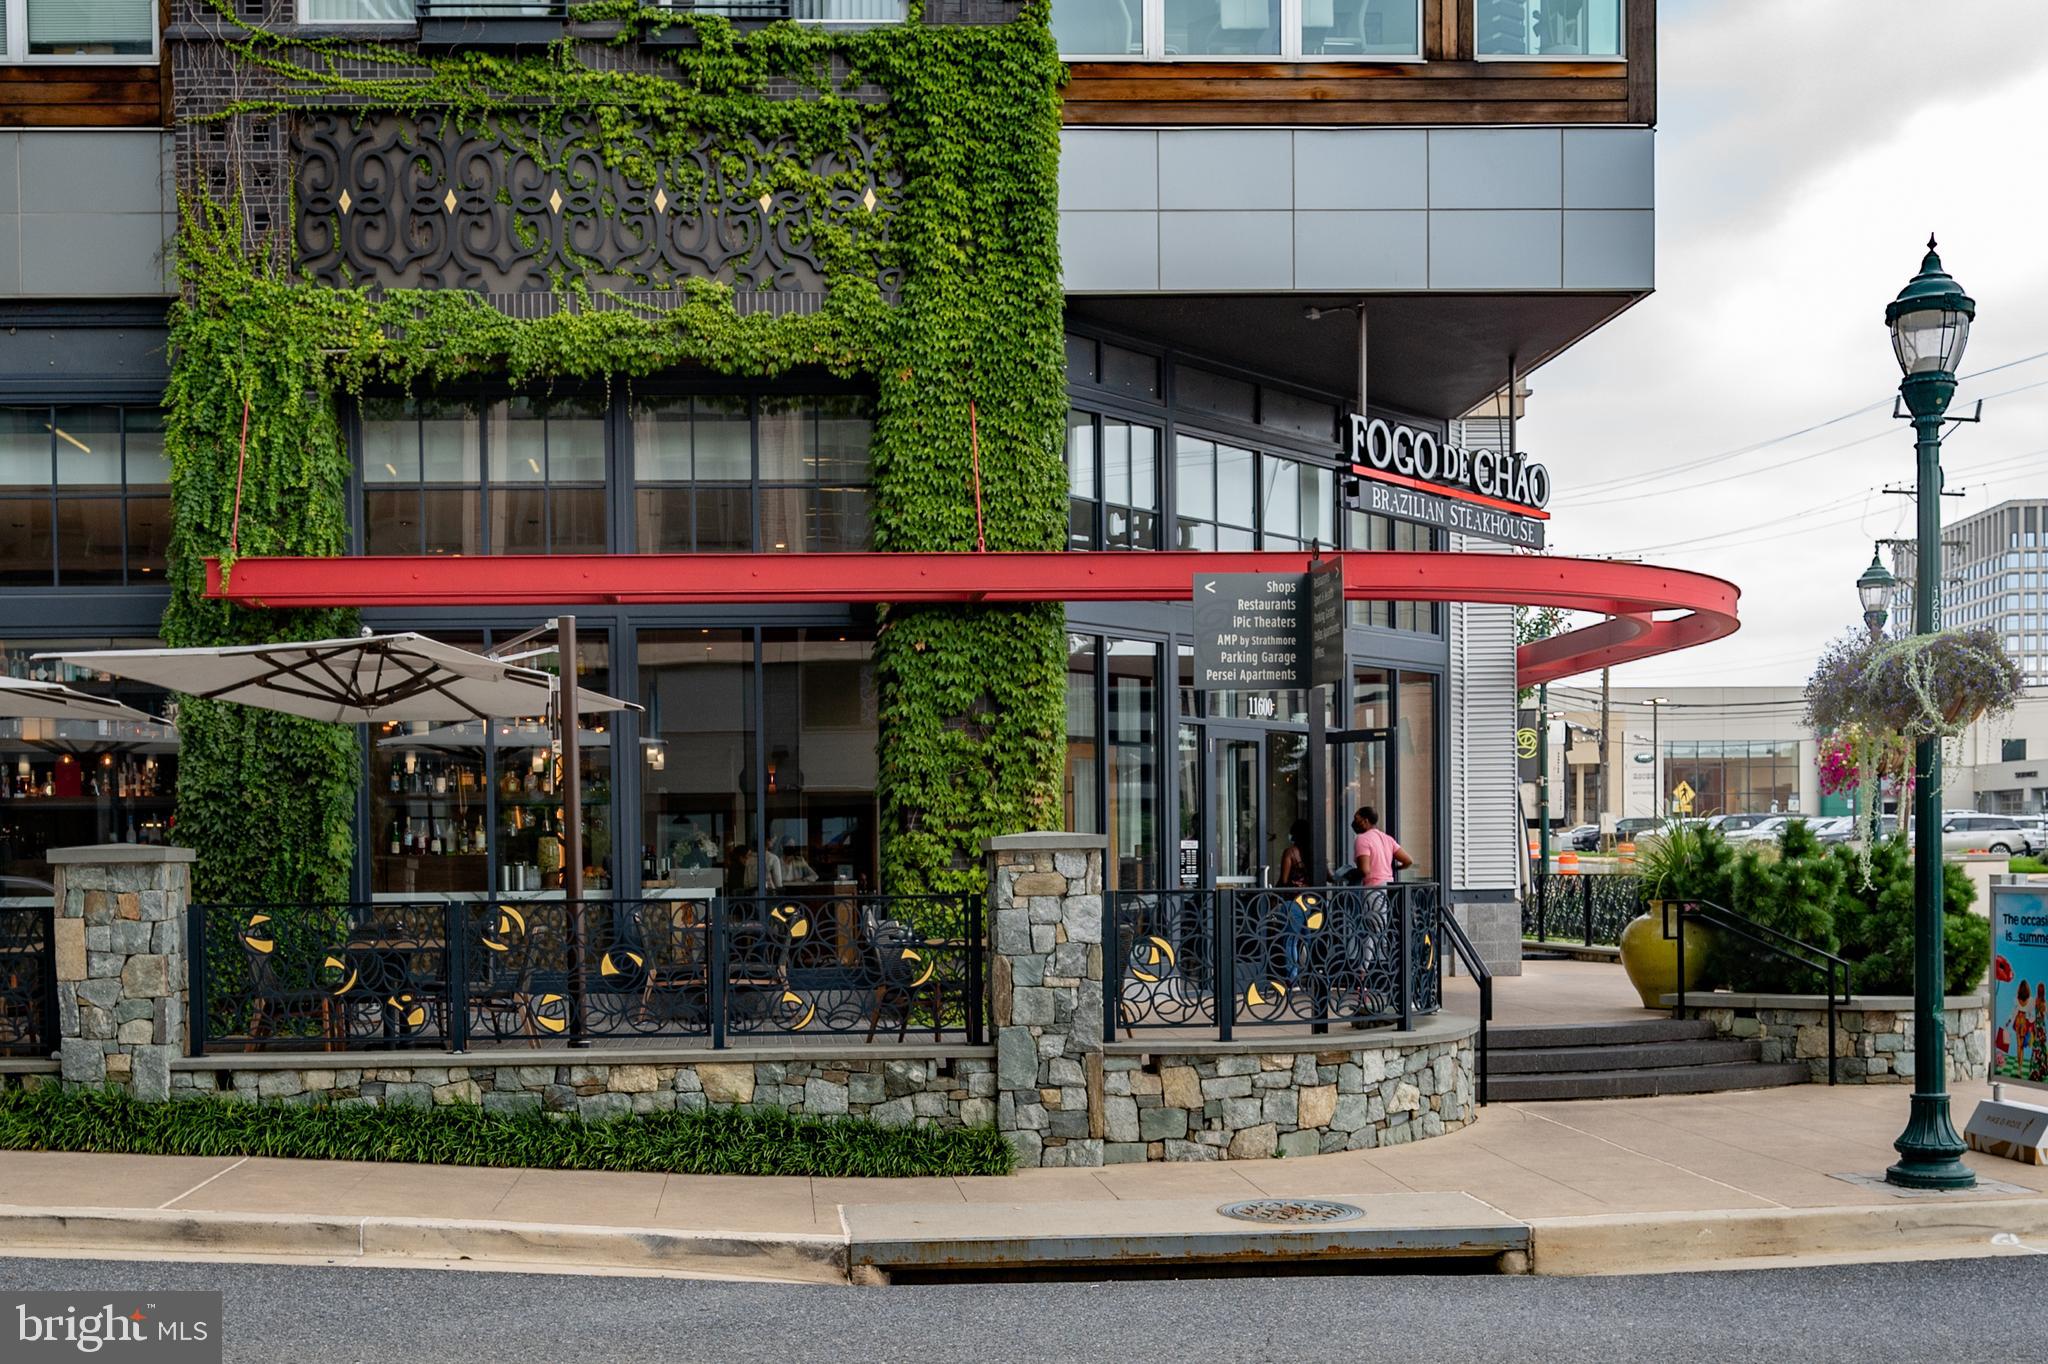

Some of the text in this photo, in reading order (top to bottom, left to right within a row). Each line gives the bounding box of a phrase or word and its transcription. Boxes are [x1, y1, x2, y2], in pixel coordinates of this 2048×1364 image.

[1350, 414, 1550, 508] FOGO DE CHÃO
[1372, 487, 1535, 543] BRAZILIAN STEAKHOUSE
[1266, 581, 1296, 595] Shops
[1238, 599, 1296, 611] Restaurants
[1233, 616, 1296, 628] iPic Theaters
[1217, 634, 1296, 648] AMP by Strathmore
[1221, 651, 1296, 665] Parking Garage
[1206, 669, 1296, 683] Persei Apartments
[1248, 696, 1273, 716] 11600
[2003, 913, 2019, 926] The
